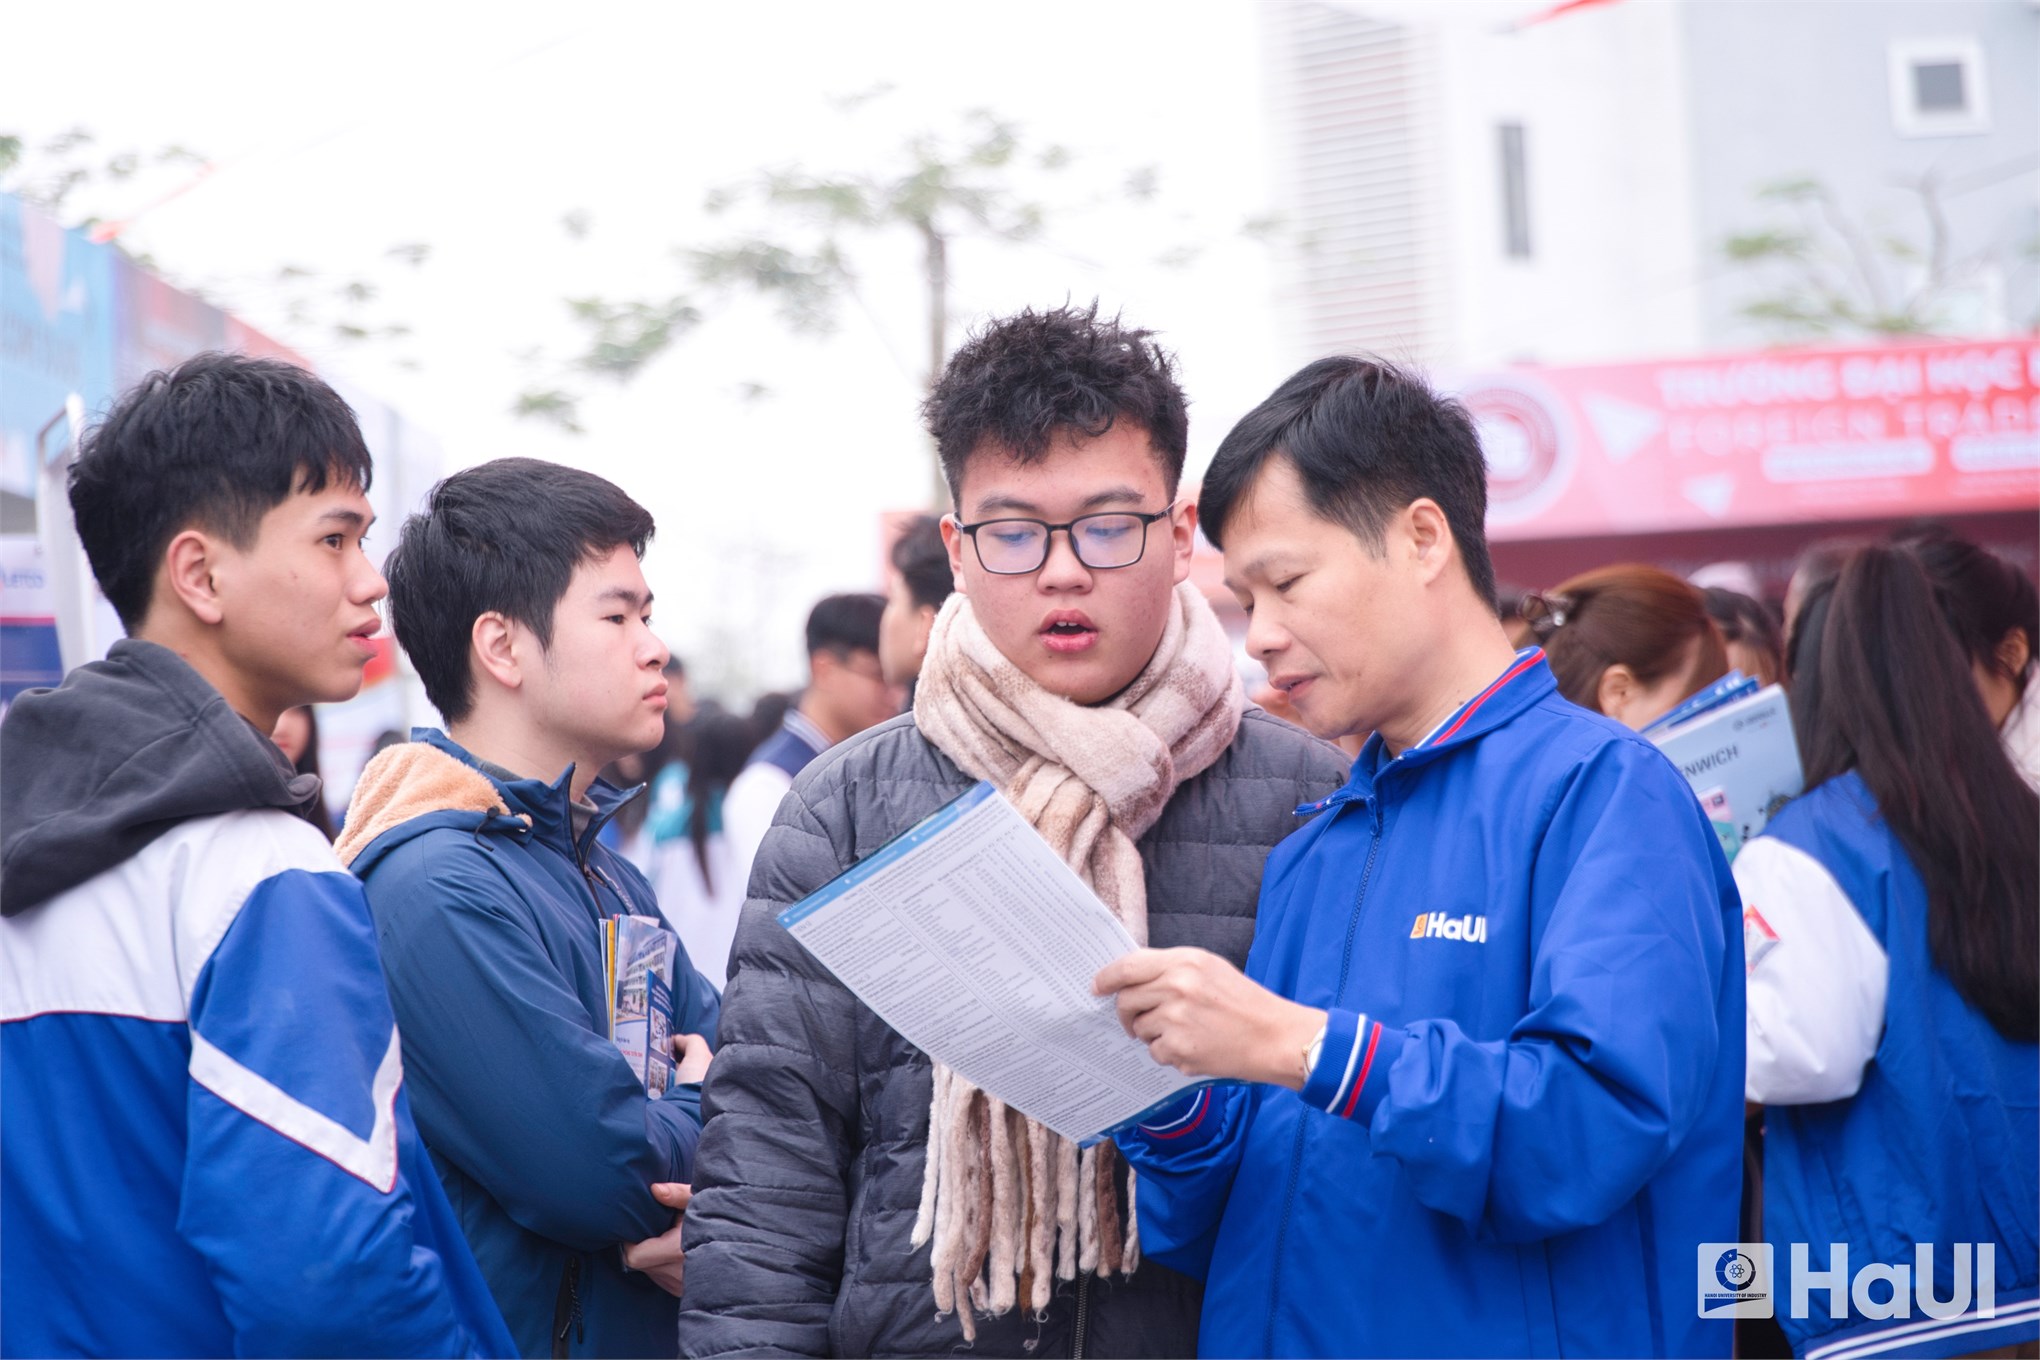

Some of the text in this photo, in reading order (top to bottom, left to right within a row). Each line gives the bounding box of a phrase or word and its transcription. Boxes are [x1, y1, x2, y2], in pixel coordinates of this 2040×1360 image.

[1668, 405, 1886, 457] FOREIGN
[1679, 744, 1738, 778] NWICH
[1425, 912, 1487, 944] HaUI
